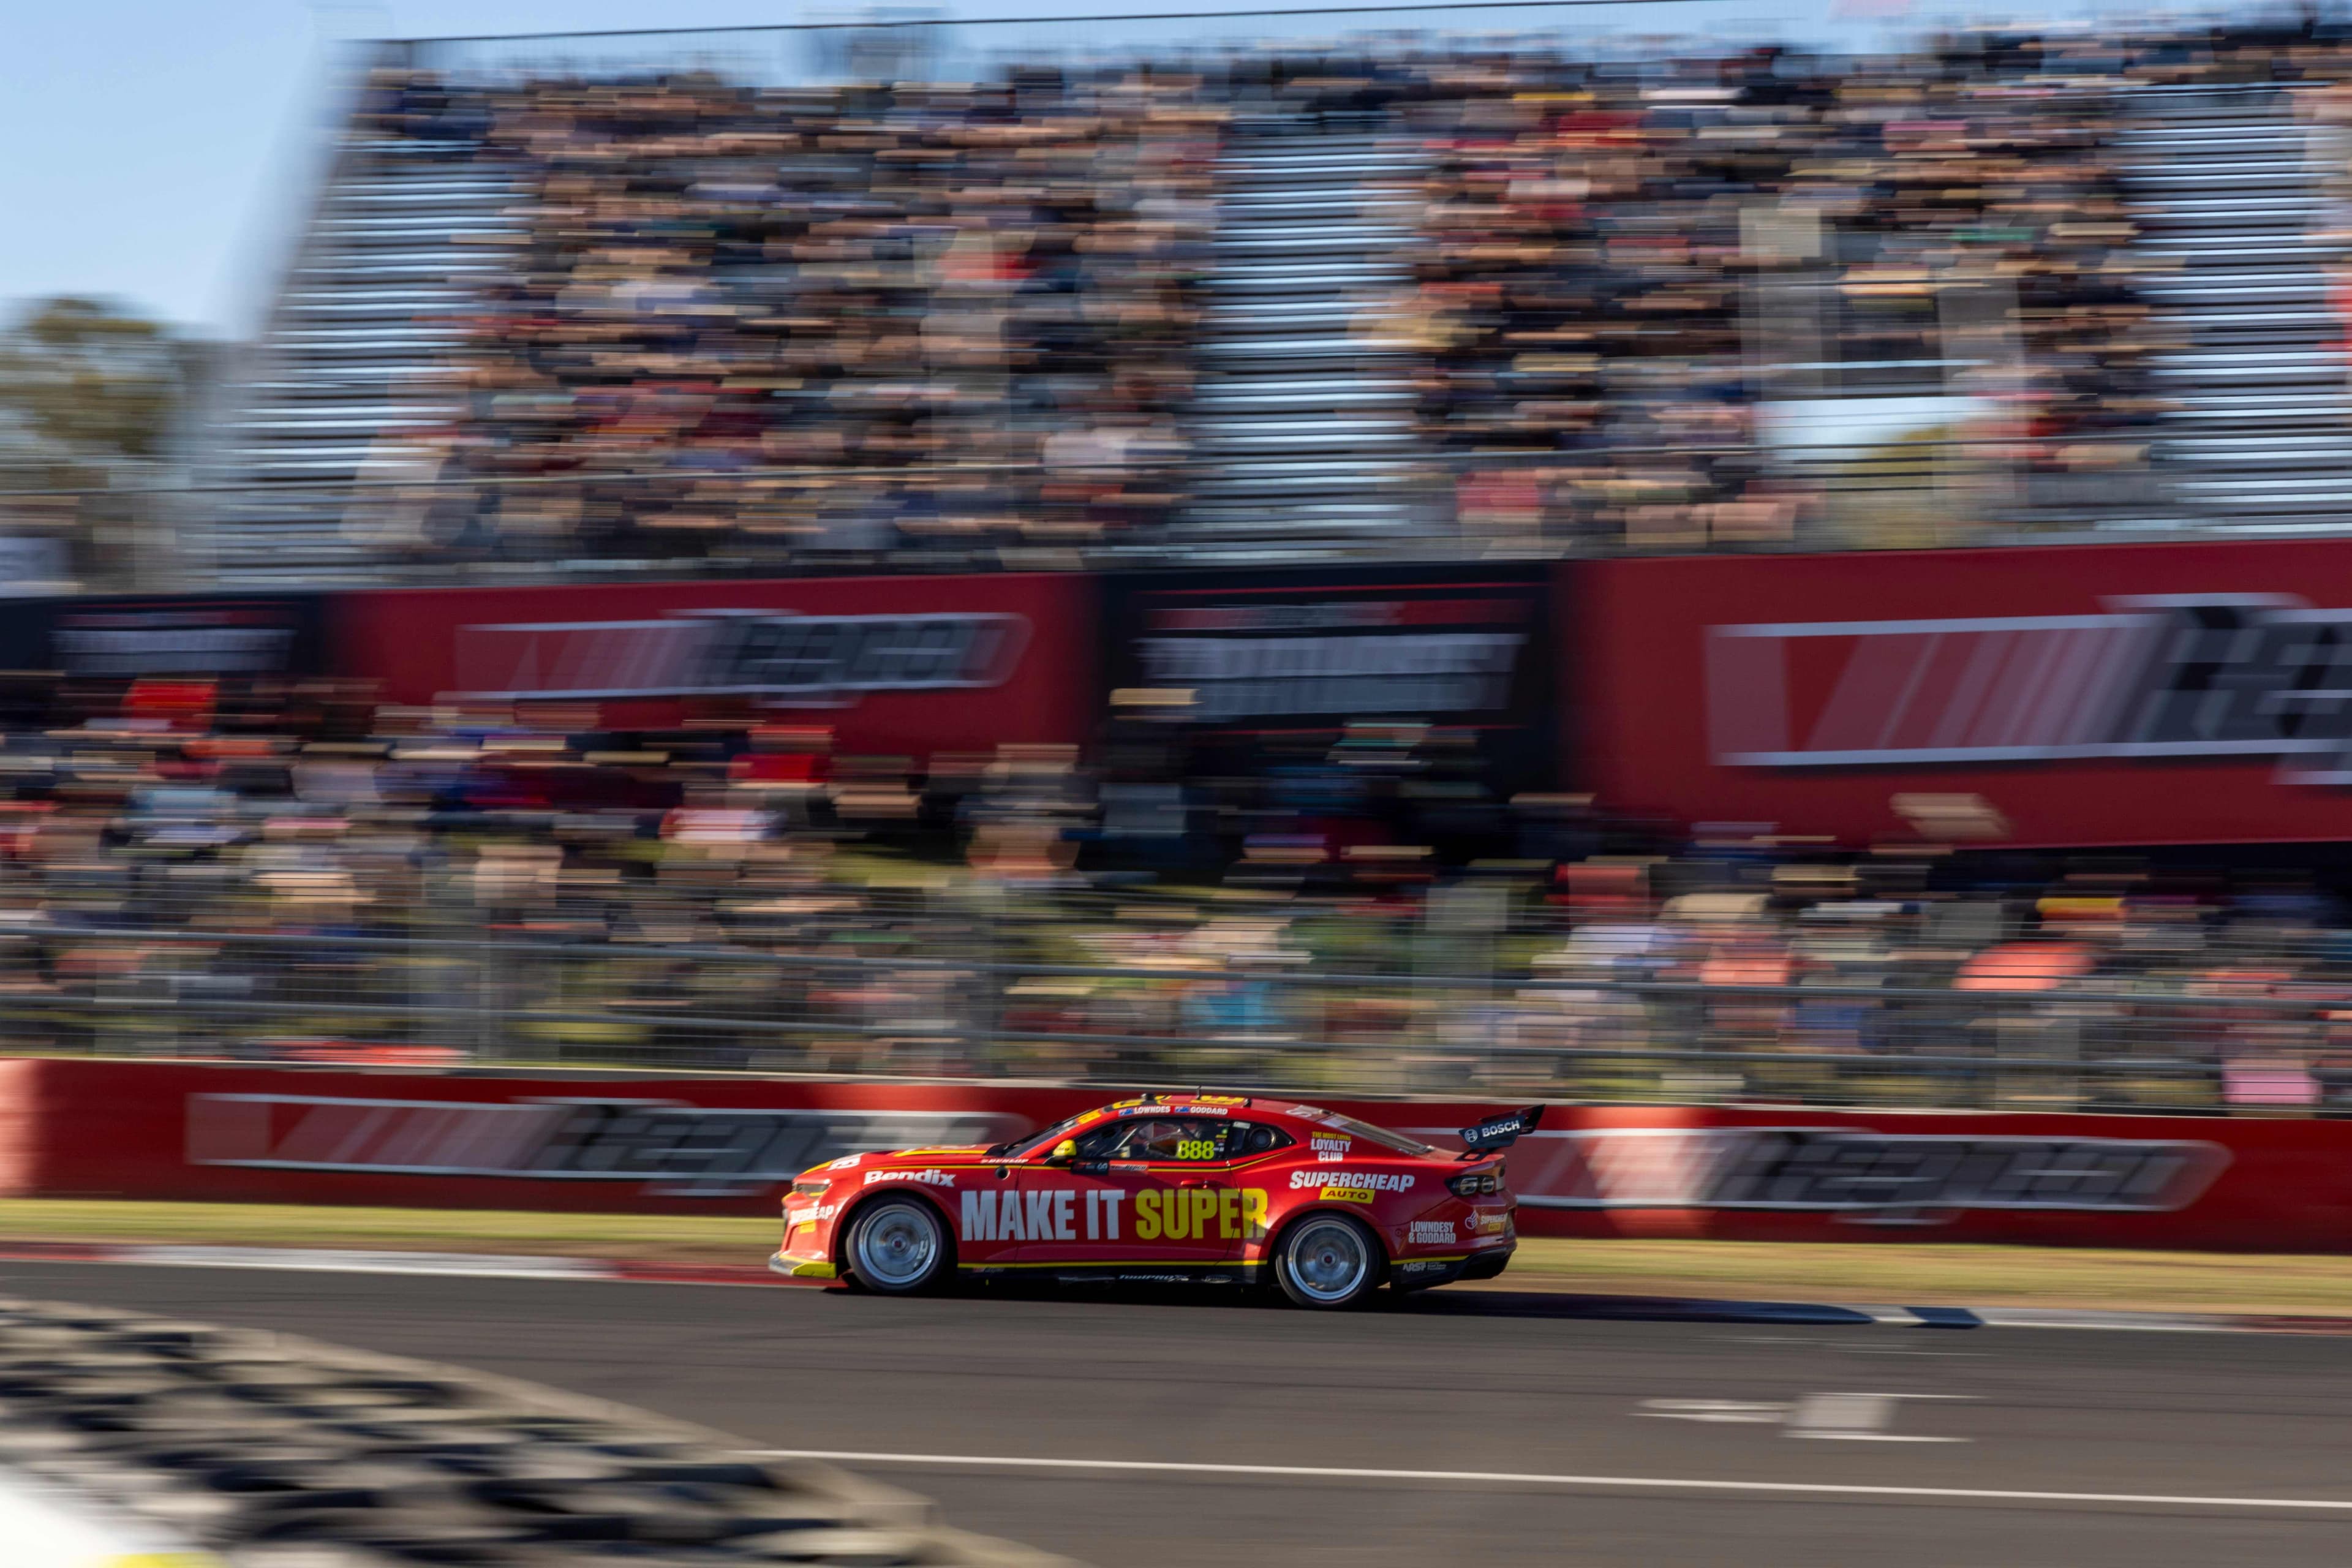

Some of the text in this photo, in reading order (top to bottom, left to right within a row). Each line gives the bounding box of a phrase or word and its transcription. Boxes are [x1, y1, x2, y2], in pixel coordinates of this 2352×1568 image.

[1133, 1106, 1170, 1115] LOWNDES
[1189, 1106, 1229, 1116] GODDARD
[1482, 1120, 1520, 1137] BOSCH
[1177, 1140, 1215, 1159] 888
[1310, 1139, 1351, 1152] LOYALTY
[1317, 1152, 1343, 1162] CLUB
[863, 1169, 957, 1187] Bendix
[1289, 1170, 1415, 1193] SUPERCHEAP
[1326, 1190, 1368, 1199] AUTO
[962, 1188, 1268, 1241] MAKE IT SUPER
[1410, 1221, 1454, 1232] LOWNDESY
[1409, 1233, 1456, 1244] & GODDARD
